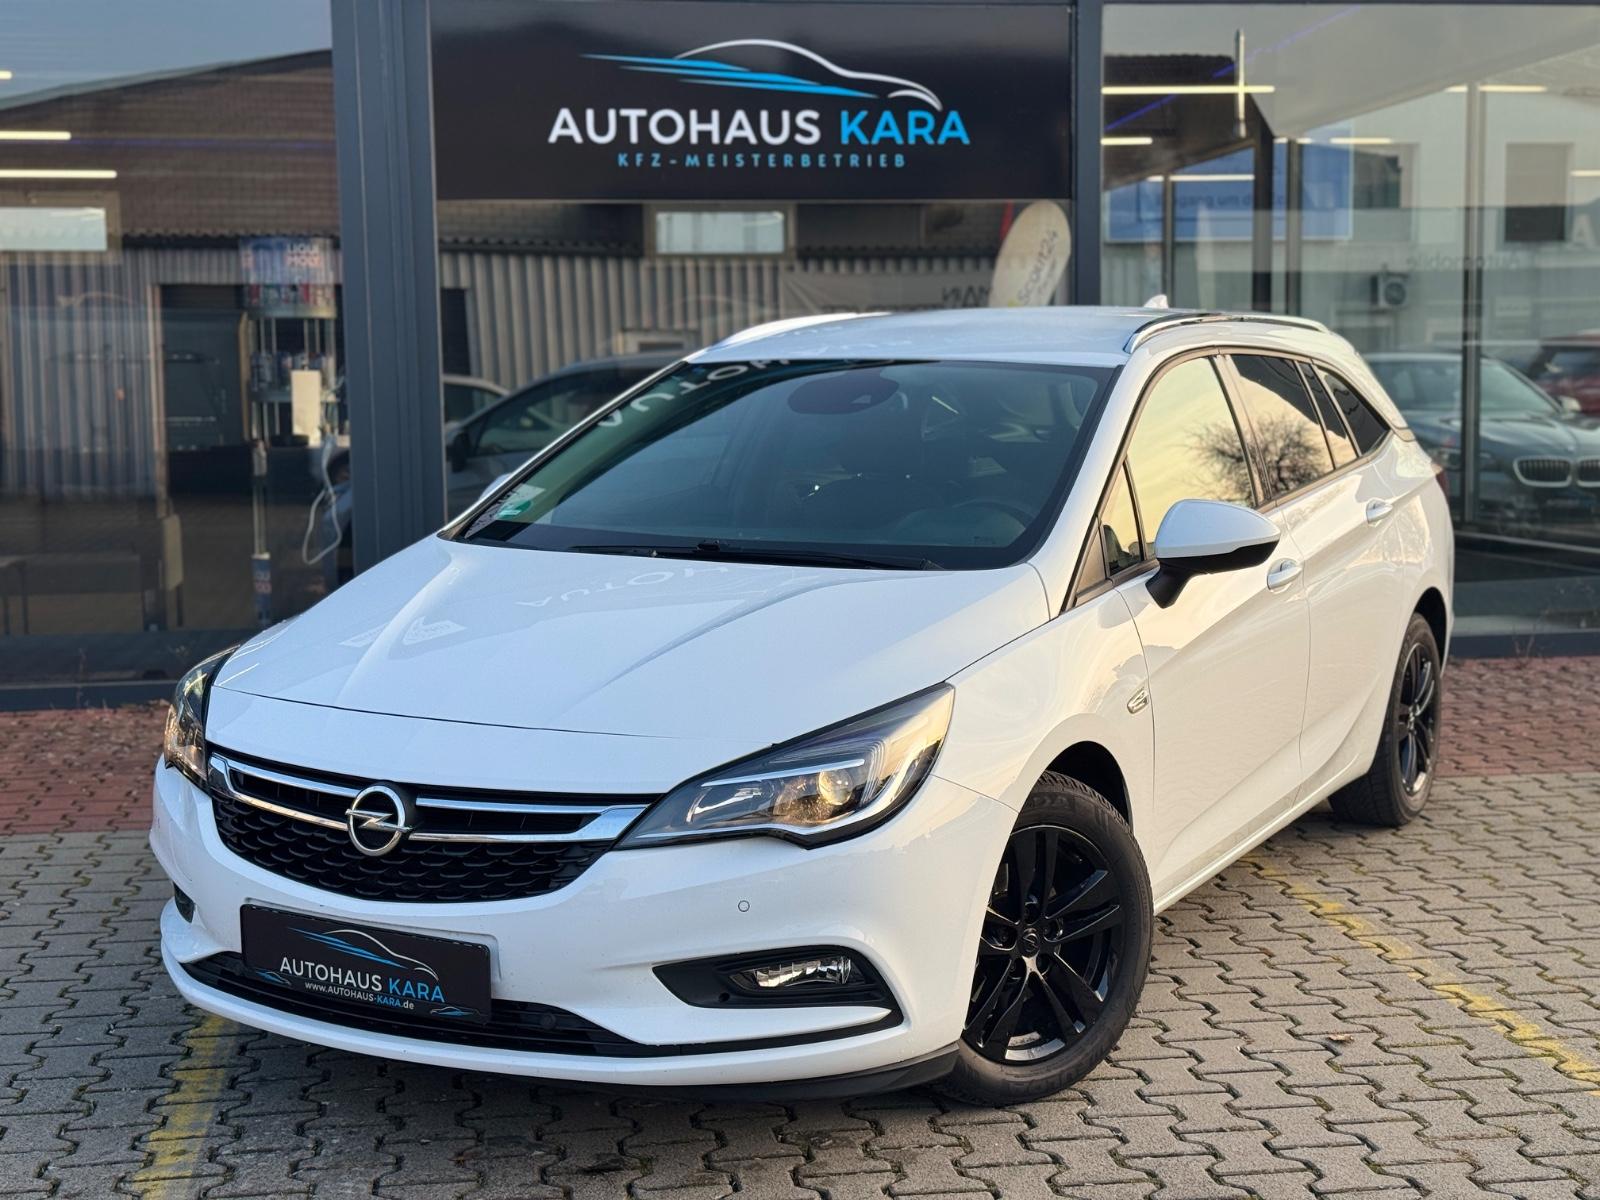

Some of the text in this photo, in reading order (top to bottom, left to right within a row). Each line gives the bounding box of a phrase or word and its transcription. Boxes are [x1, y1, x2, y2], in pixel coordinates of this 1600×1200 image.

[548, 108, 970, 145] AUTOHAUS KARA
[617, 153, 906, 168] KFZ-MEISTERBETRIEB
[280, 957, 445, 1003] AUTOHAUS KARA
[305, 982, 415, 1010] www.AUTOHAUS-KARA.de
